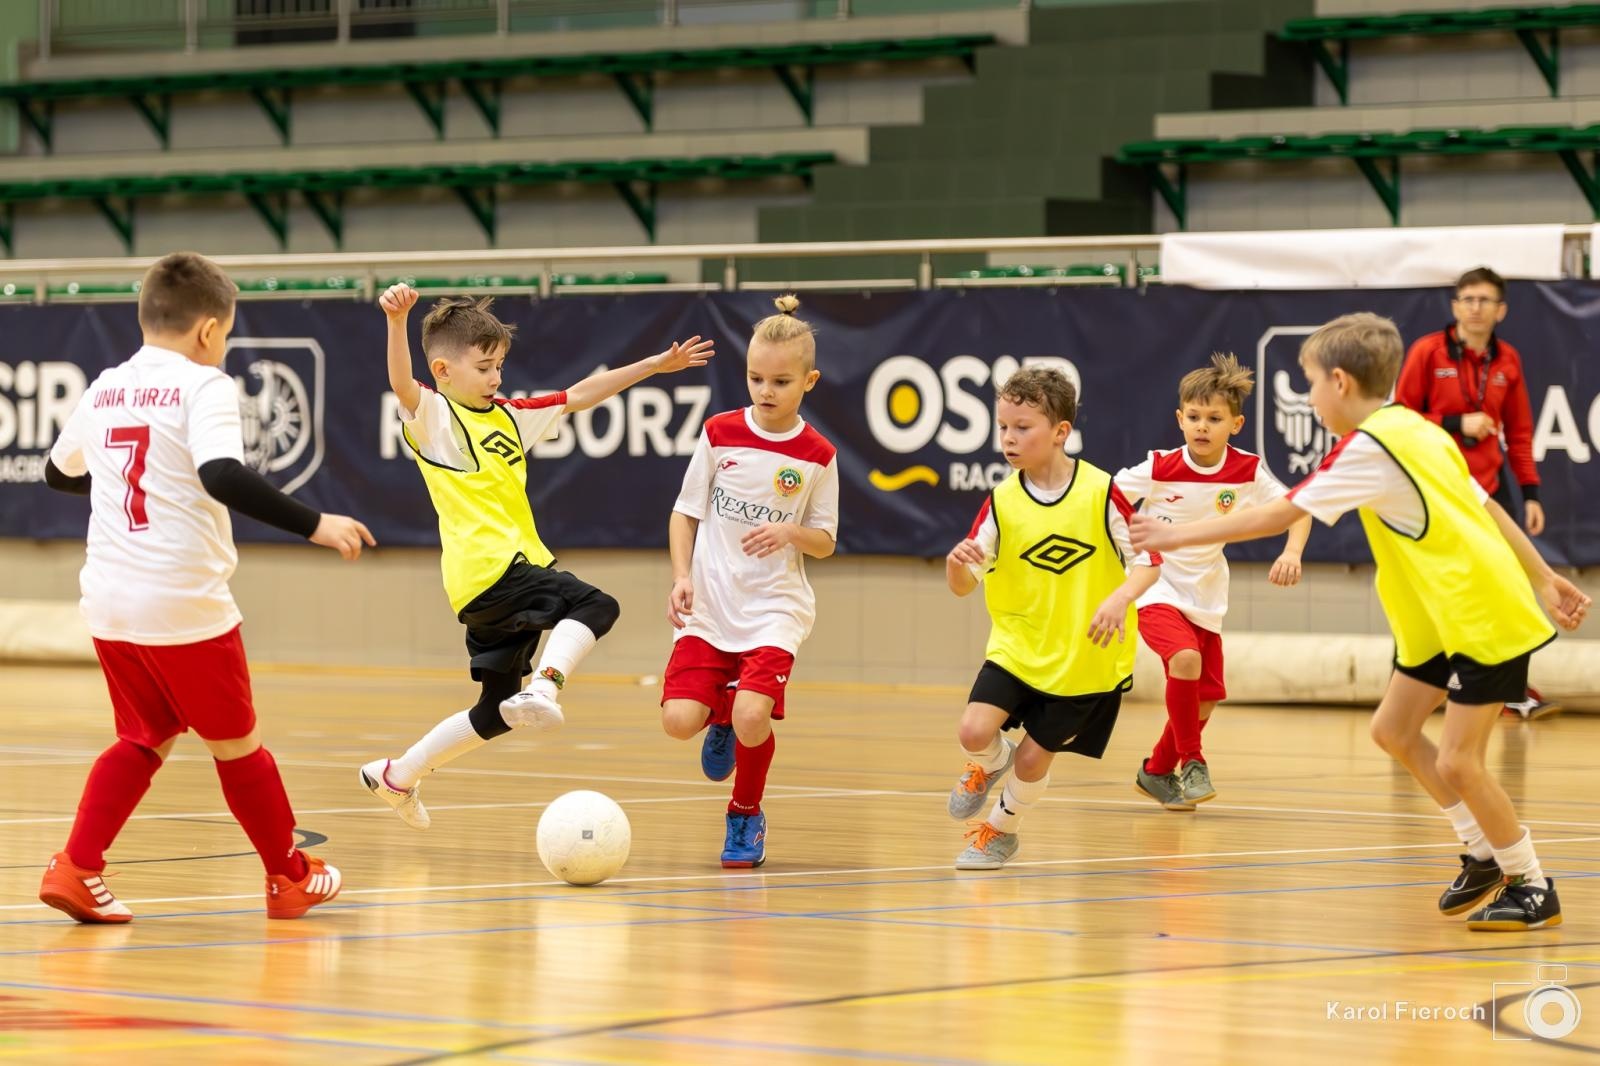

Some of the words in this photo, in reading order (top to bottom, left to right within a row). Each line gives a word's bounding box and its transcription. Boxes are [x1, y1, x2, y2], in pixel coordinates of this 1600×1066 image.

[94, 388, 126, 409] UNIA
[132, 387, 181, 408] TURZA
[379, 364, 711, 460] RBÓRZ
[105, 424, 150, 532] 7
